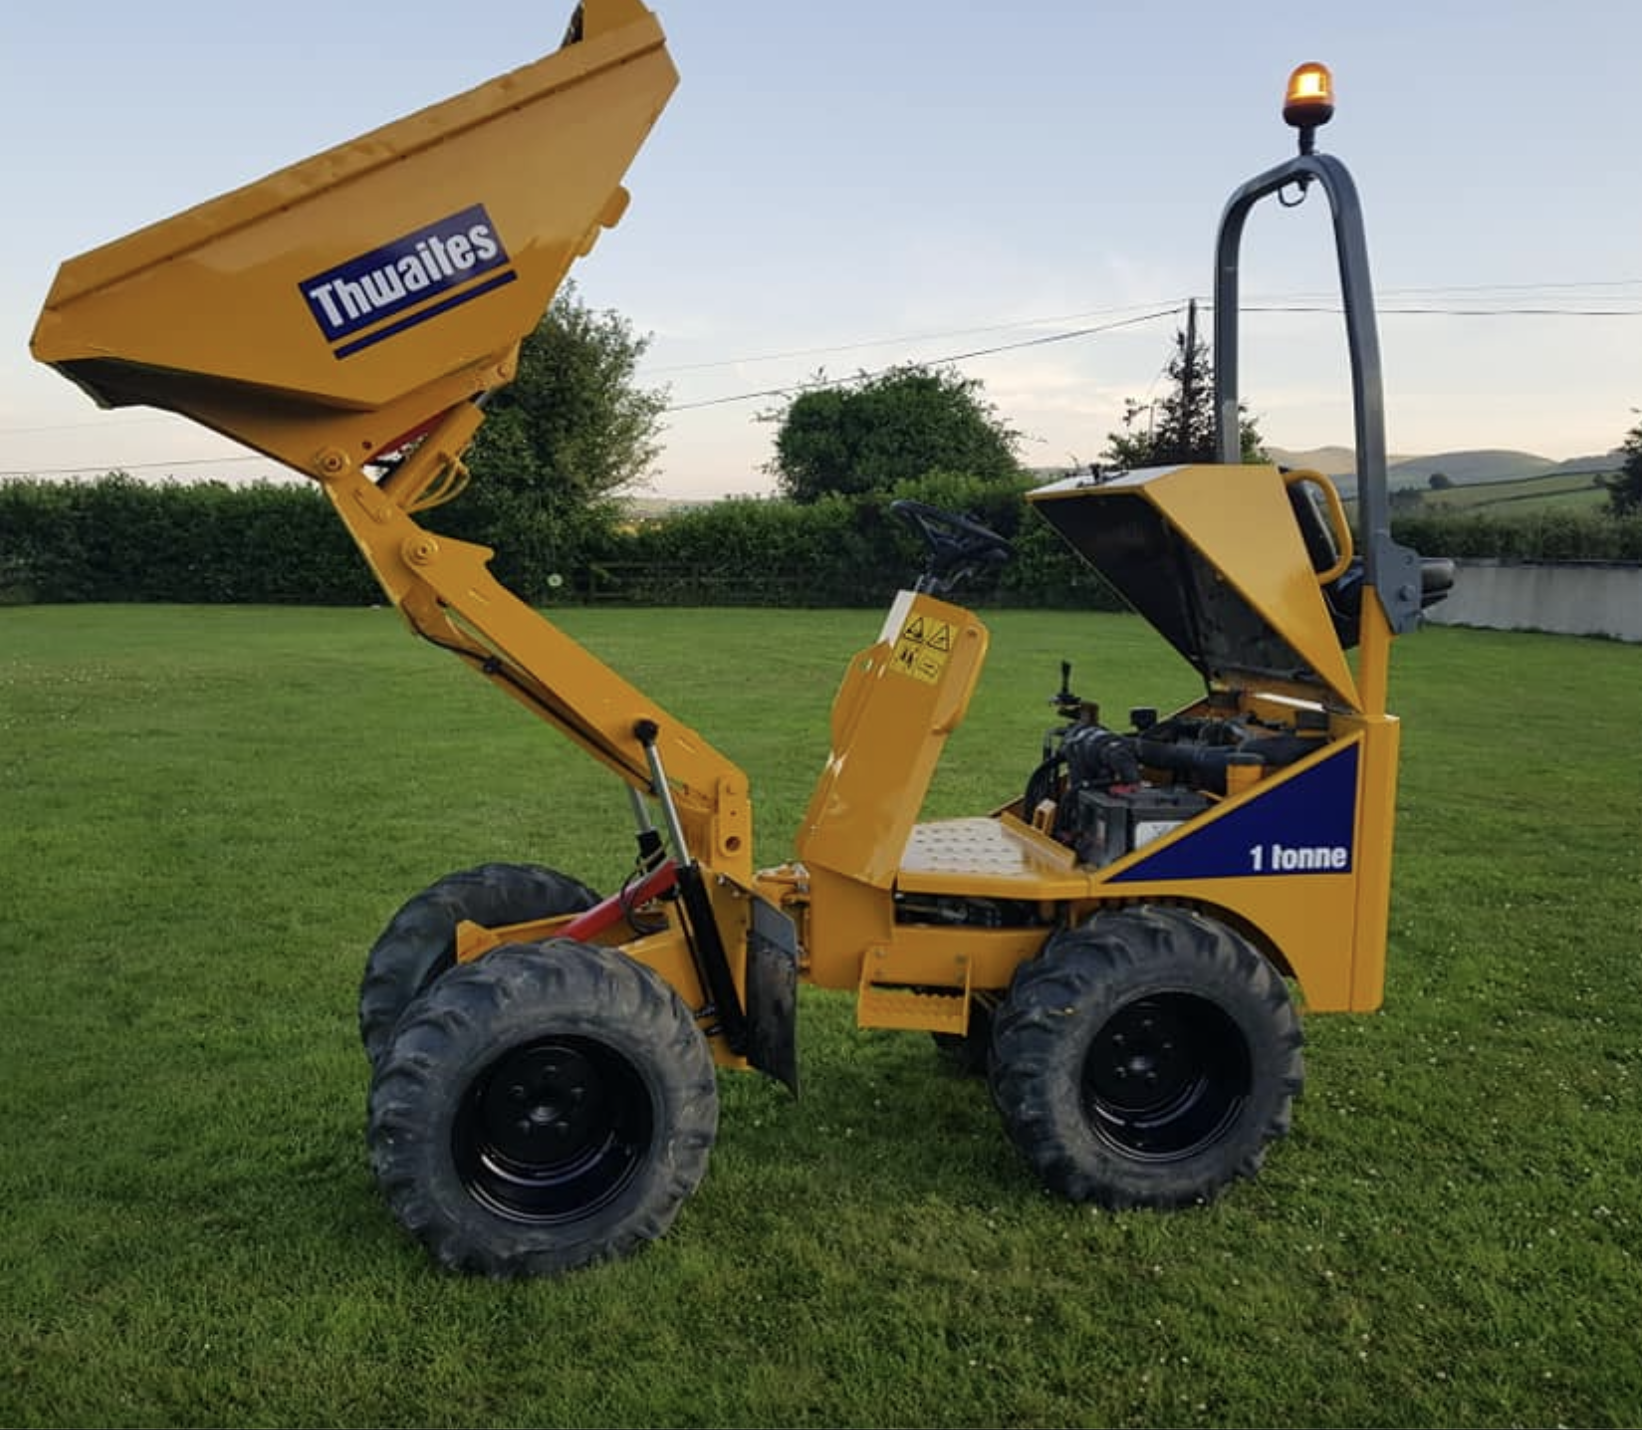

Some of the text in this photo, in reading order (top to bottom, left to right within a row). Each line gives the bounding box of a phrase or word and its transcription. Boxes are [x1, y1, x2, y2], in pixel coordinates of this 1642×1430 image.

[309, 224, 498, 327] Thwaites
[1250, 843, 1348, 871] 1 tonne
